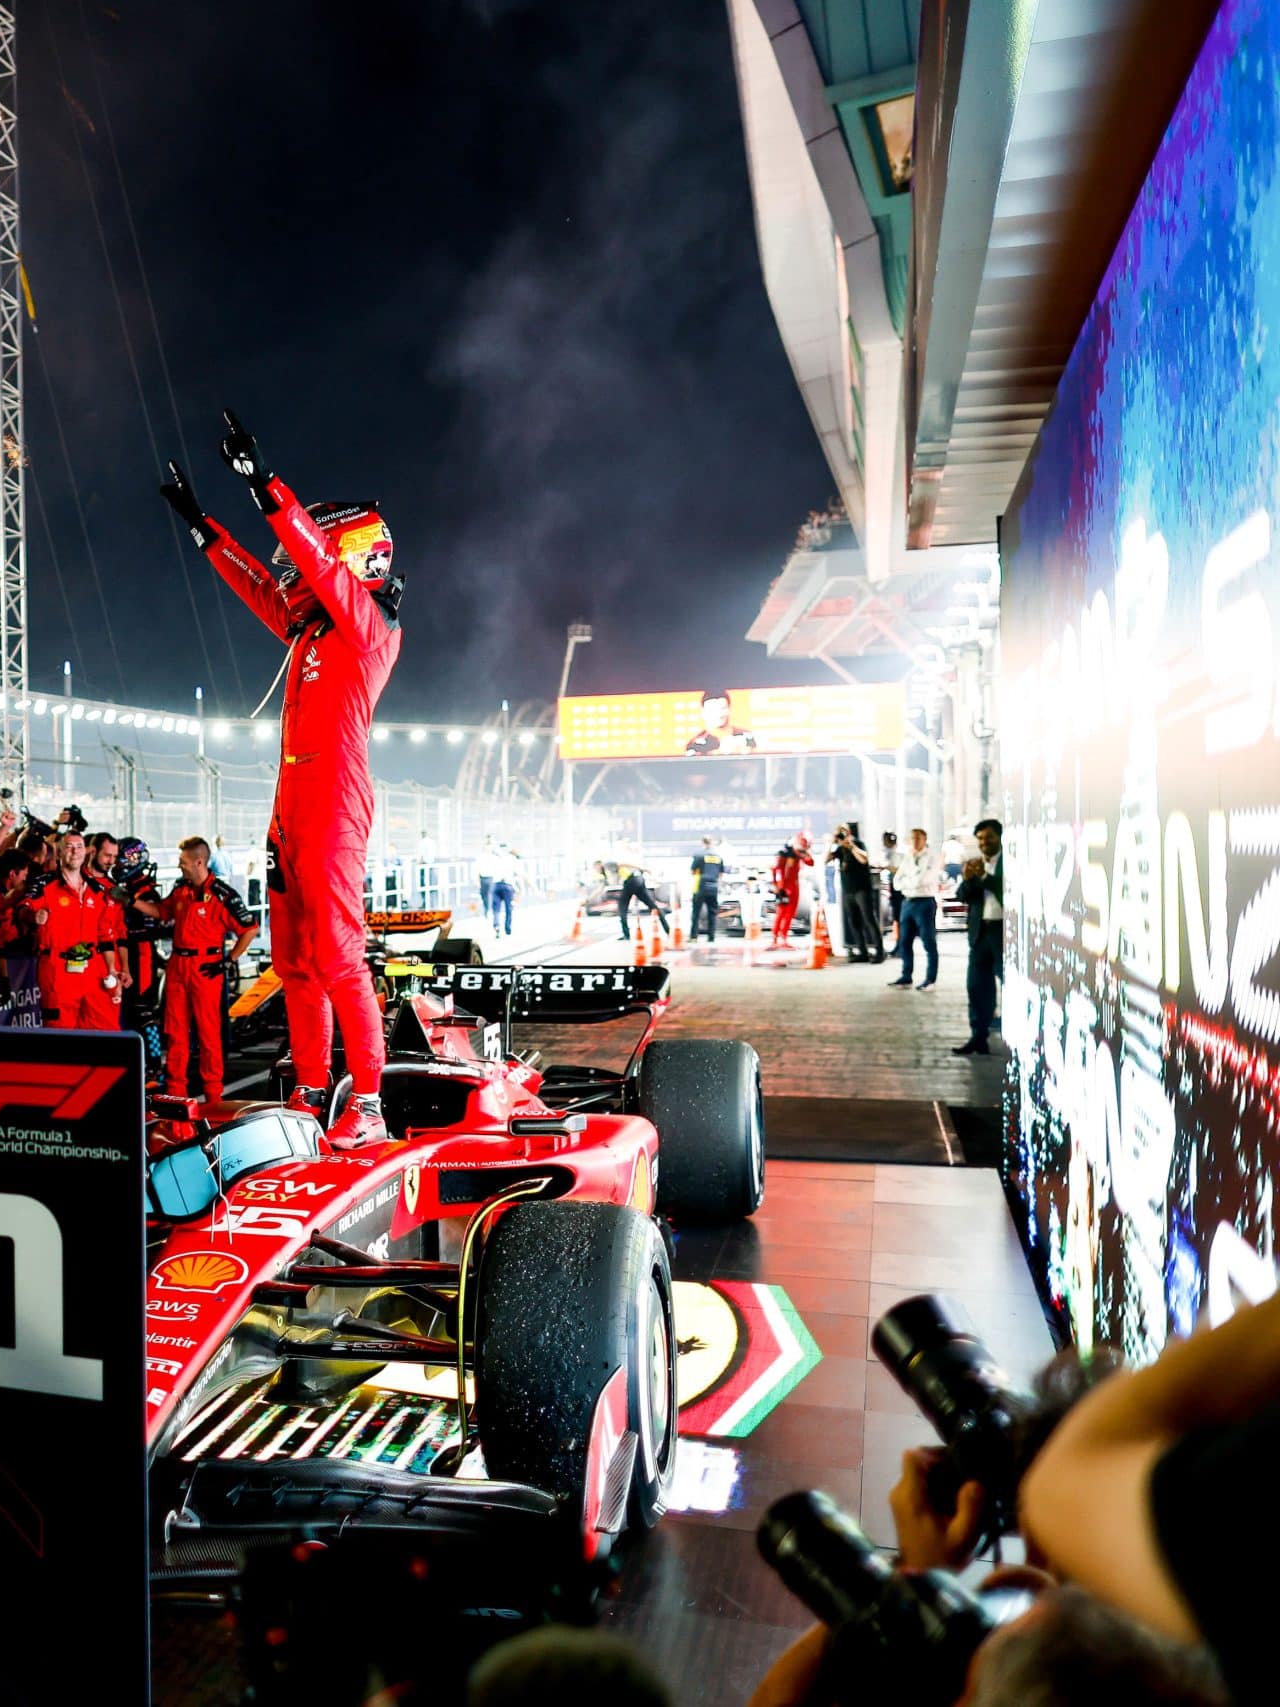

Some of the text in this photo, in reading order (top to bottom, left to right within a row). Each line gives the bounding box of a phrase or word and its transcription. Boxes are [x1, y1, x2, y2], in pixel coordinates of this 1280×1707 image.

[8, 1127, 63, 1142] Formula
[65, 1131, 72, 1143] 1
[338, 1181, 399, 1234] RICHARD MILLE
[147, 1300, 201, 1315] aws
